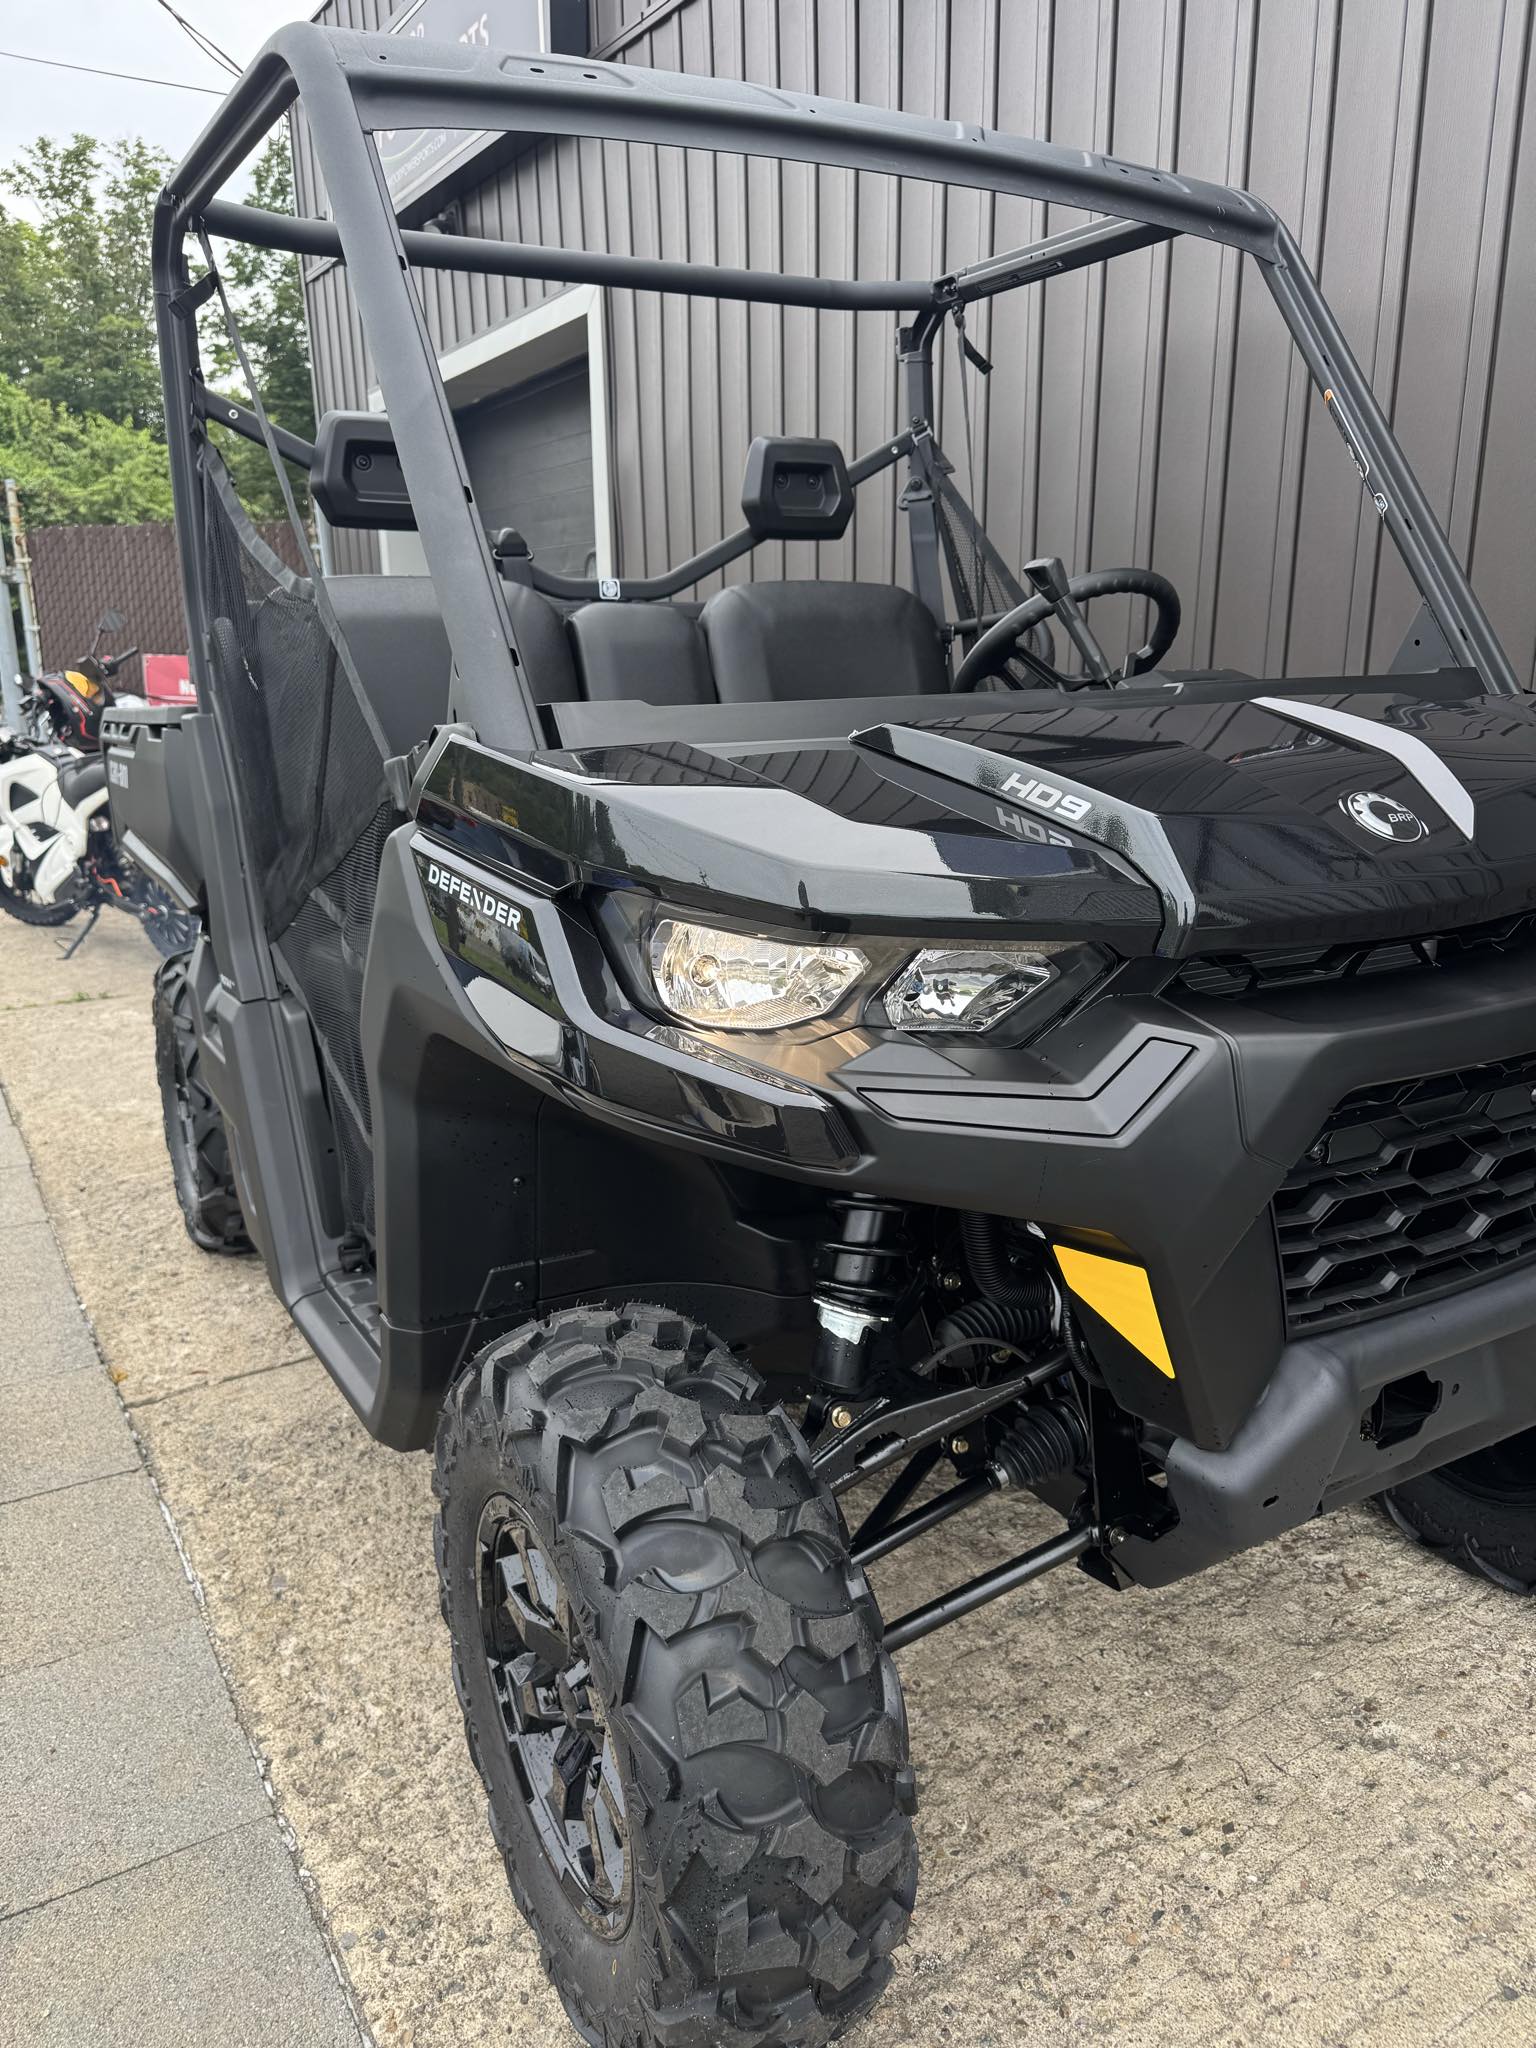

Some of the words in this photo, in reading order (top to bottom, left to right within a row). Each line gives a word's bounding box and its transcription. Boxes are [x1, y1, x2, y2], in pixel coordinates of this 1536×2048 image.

[1000, 772, 1092, 821] HD9
[1387, 812, 1415, 824] BRP
[428, 863, 522, 932] DEFENDER
